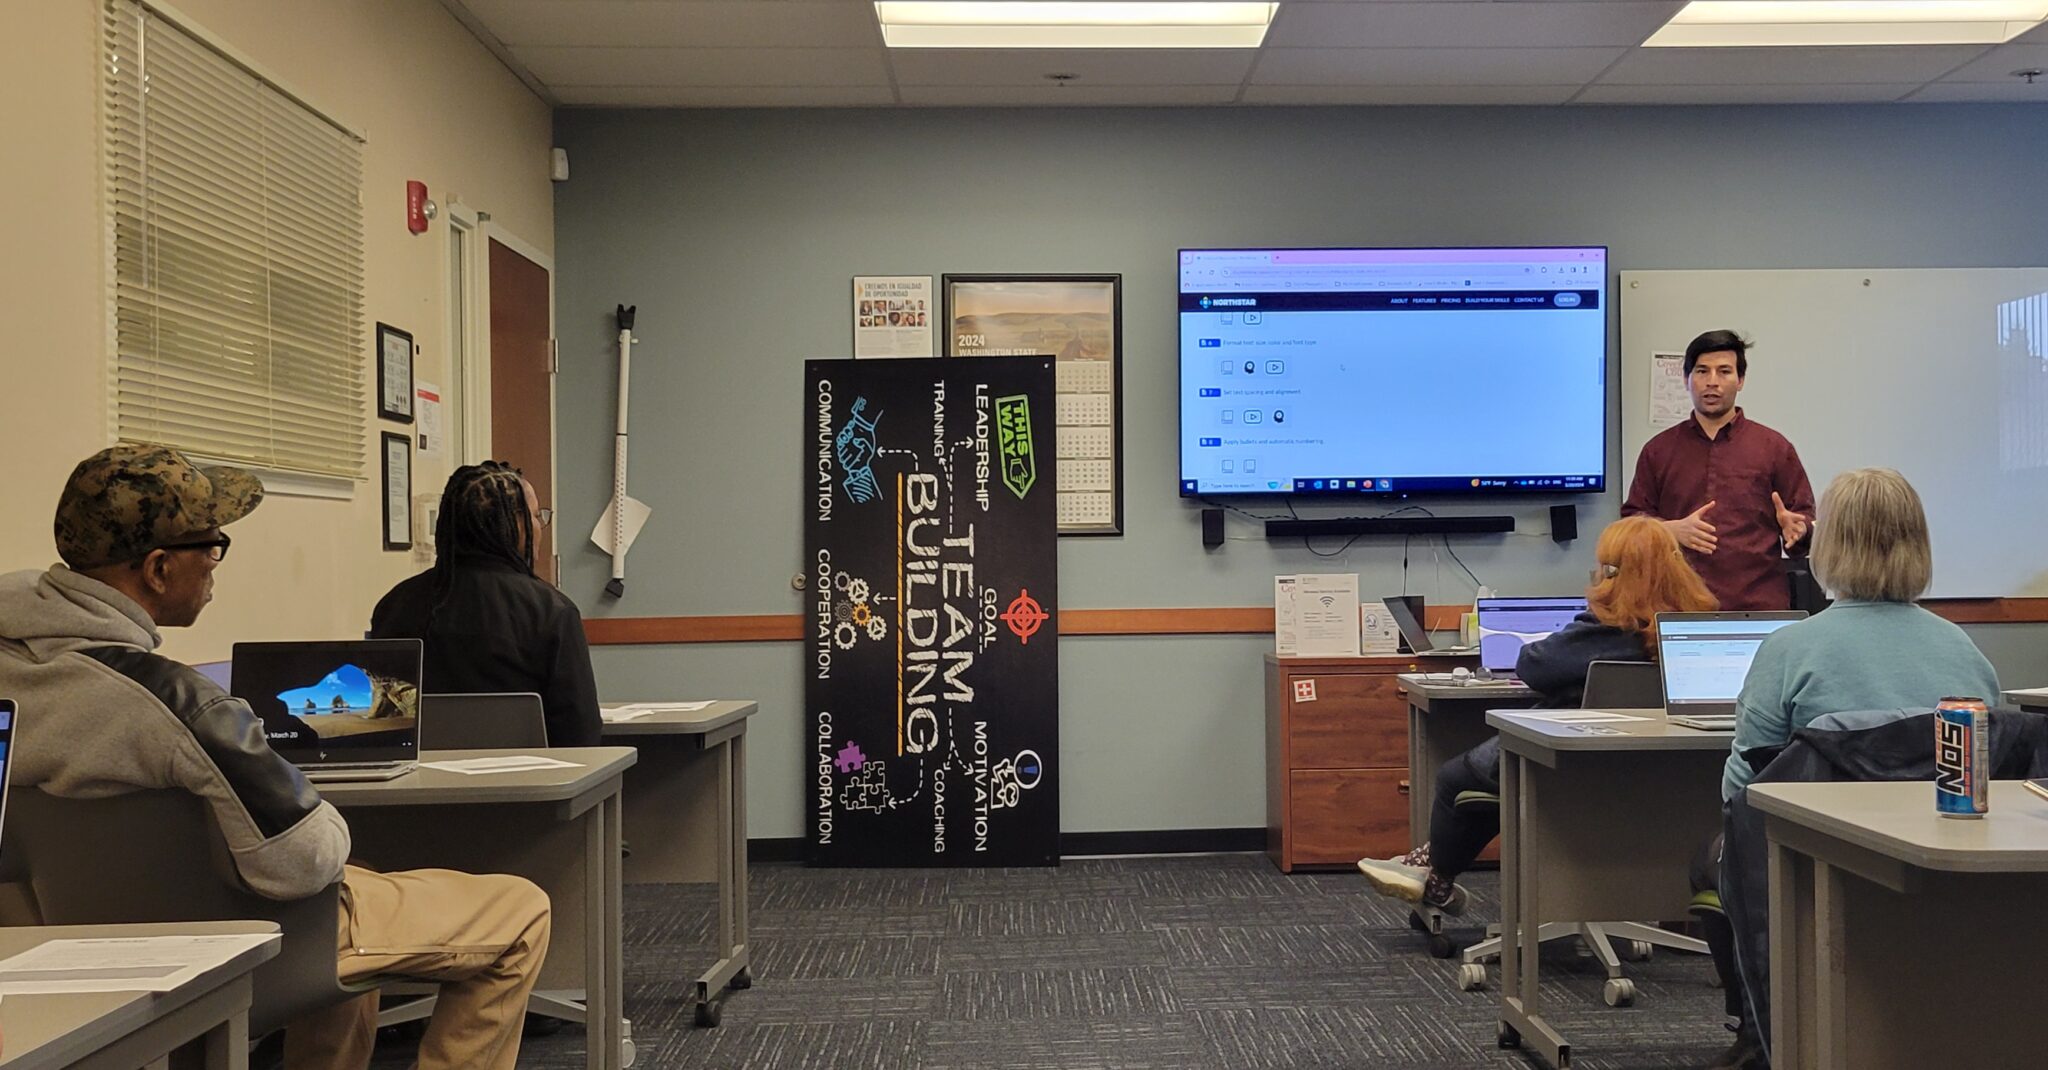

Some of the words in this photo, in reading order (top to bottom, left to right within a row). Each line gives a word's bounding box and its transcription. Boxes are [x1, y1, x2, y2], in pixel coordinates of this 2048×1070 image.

[958, 334, 985, 347] 2024
[959, 348, 1012, 357] WASHINGTON
[1013, 347, 1037, 356] STATE
[818, 379, 833, 522] COMMUNICATION
[934, 379, 945, 457] TRAINING
[975, 383, 989, 512] LEADERSHIP
[999, 404, 1017, 458] WAY
[1012, 402, 1029, 456] THIS
[817, 549, 832, 680] COOPERATION
[906, 473, 941, 754] BUILDING
[942, 523, 975, 703] TEAM
[984, 587, 998, 649] GOAL
[271, 731, 290, 739] March
[290, 731, 299, 739] 20
[1935, 714, 1965, 797] NOS
[818, 711, 833, 844] COLLABORATION
[934, 769, 946, 853] COACHING
[974, 720, 988, 852] MOTIVATION
